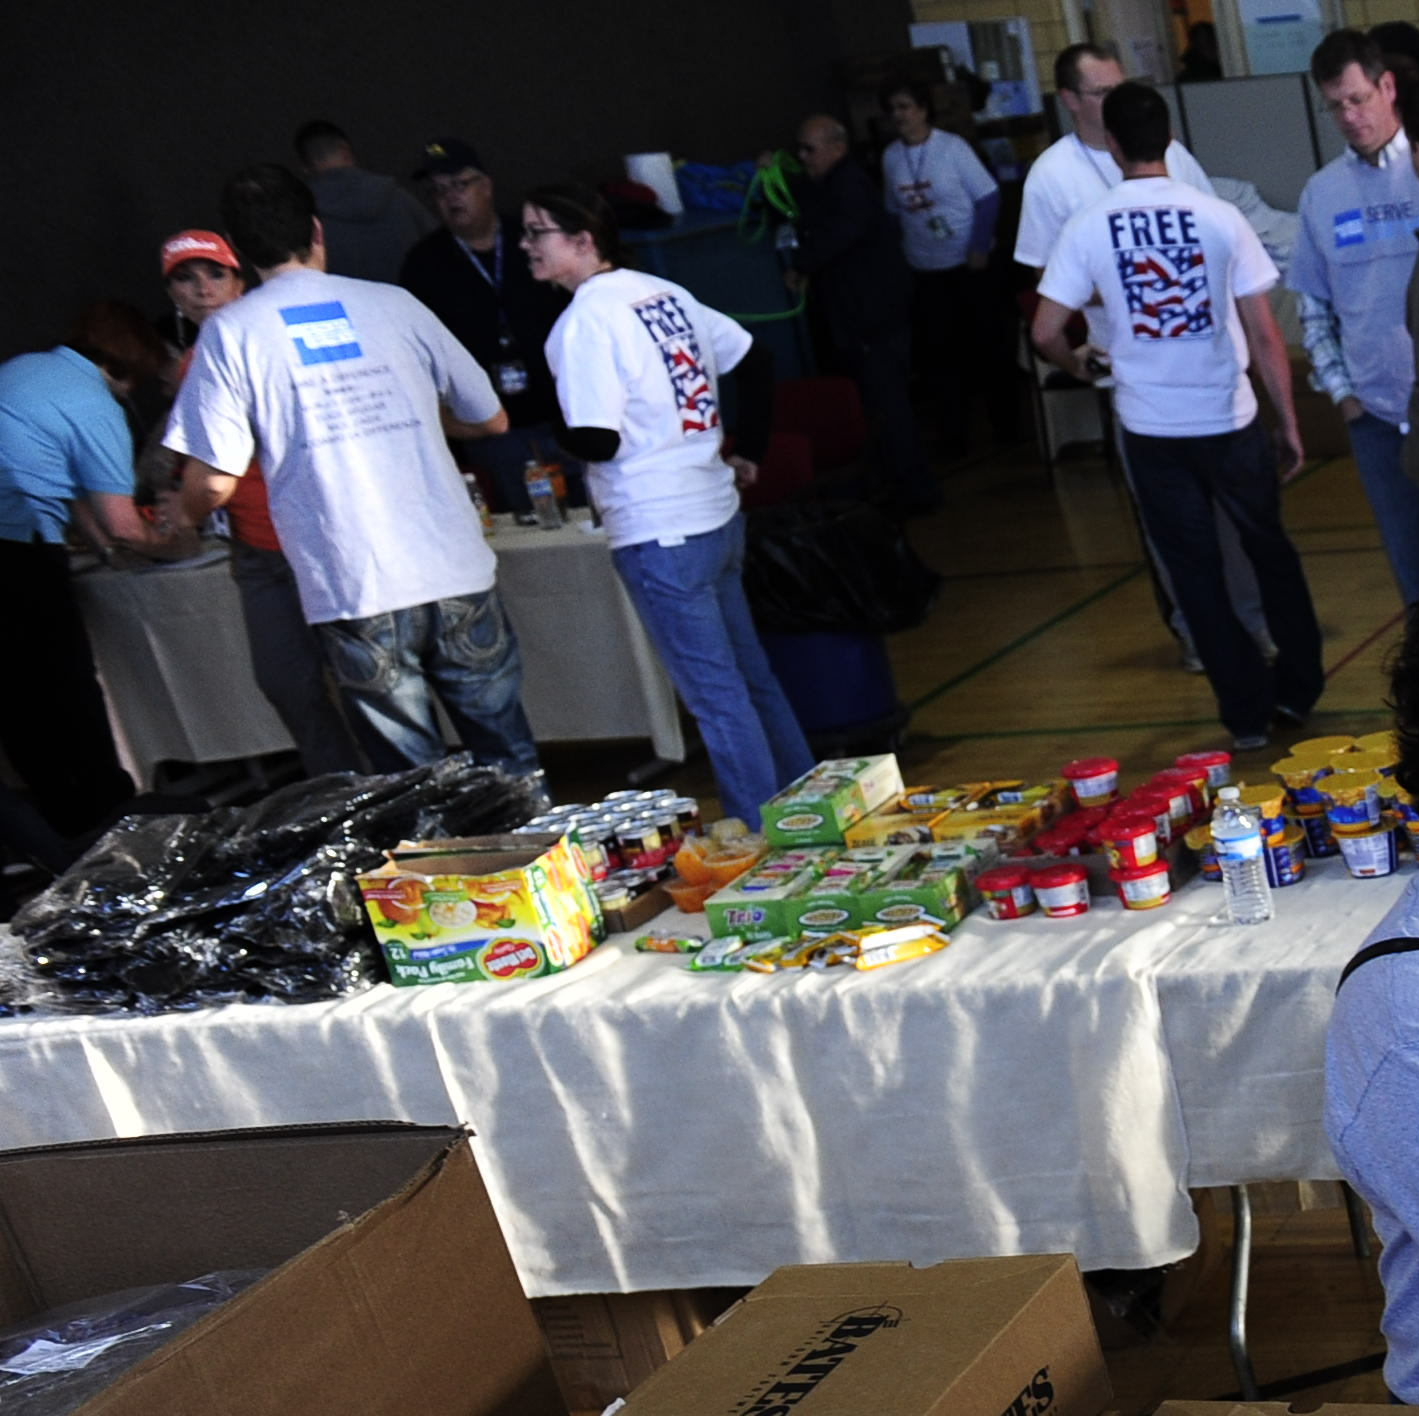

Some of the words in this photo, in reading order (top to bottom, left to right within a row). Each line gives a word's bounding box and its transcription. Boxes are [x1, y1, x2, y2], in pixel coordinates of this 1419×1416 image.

[1108, 209, 1200, 249] FREE
[726, 909, 763, 927] Trio
[390, 946, 407, 960] 12
[395, 962, 430, 981] Pack
[428, 955, 475, 977] Family
